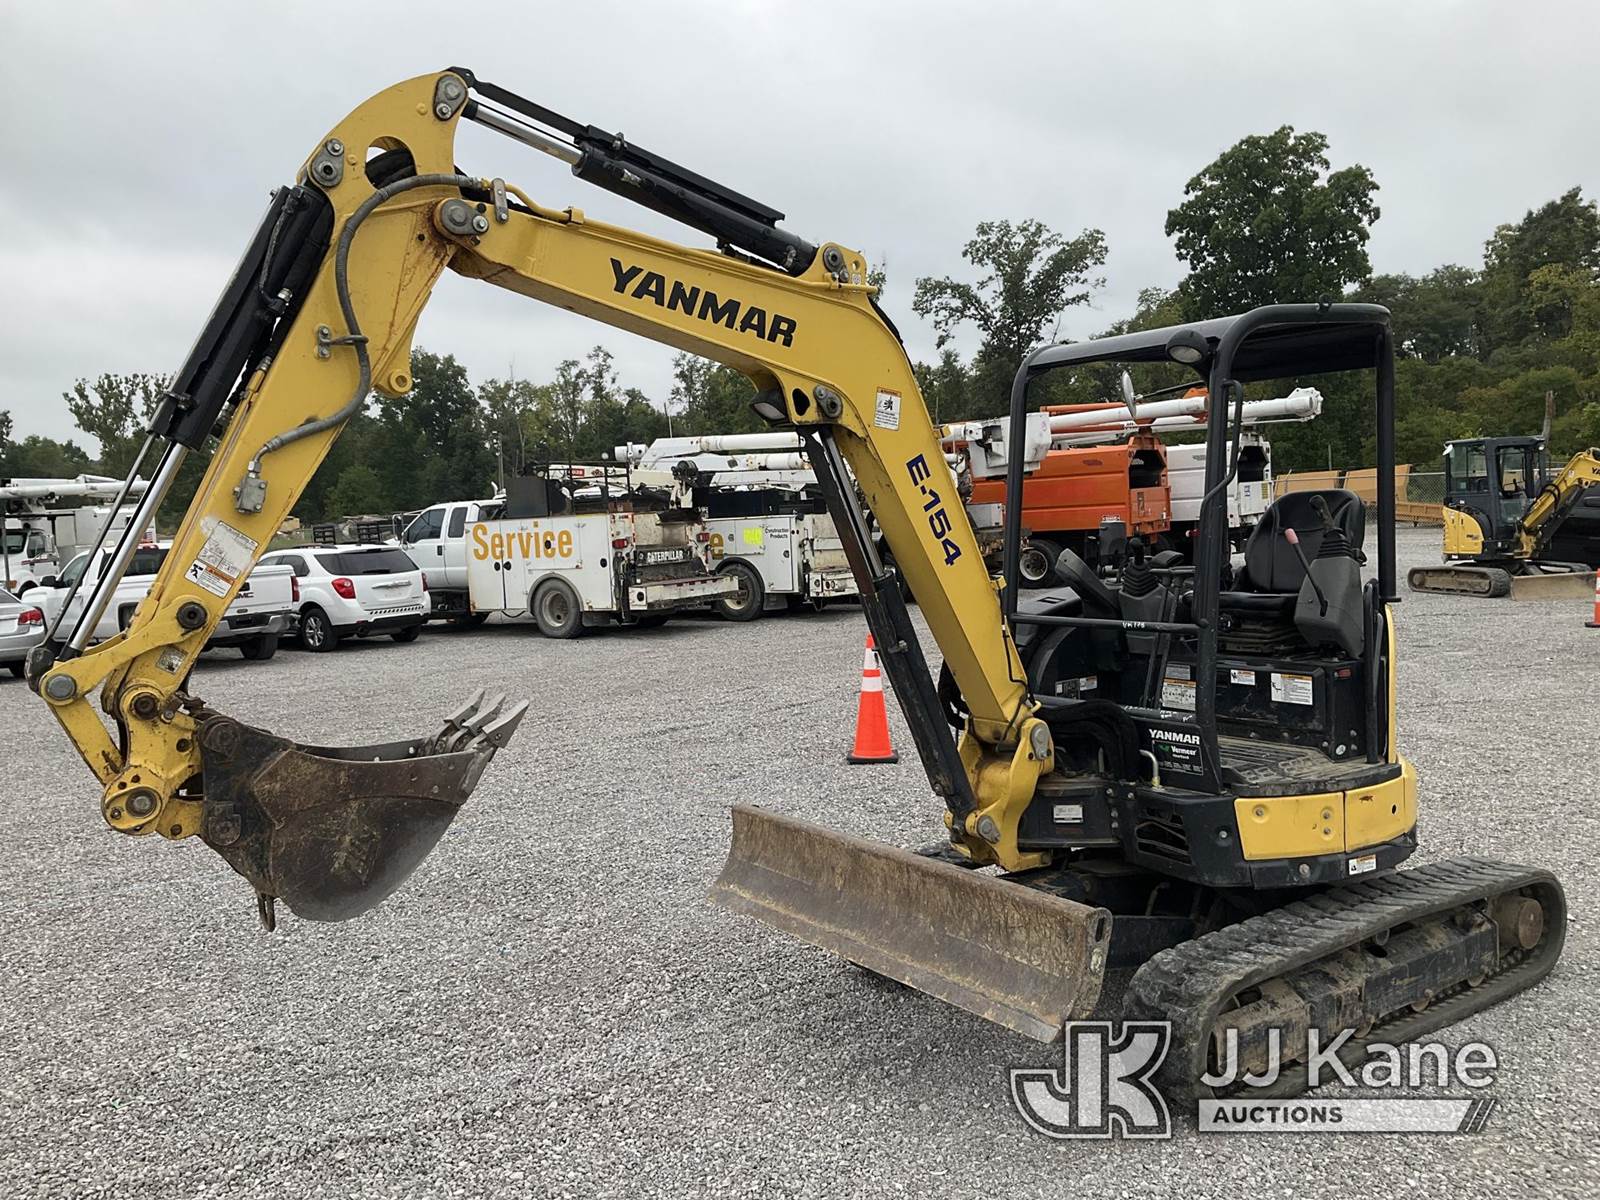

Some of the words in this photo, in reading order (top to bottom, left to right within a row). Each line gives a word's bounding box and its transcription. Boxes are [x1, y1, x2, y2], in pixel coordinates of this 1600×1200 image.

[611, 257, 797, 347] YANMAR
[905, 454, 962, 567] E-154
[472, 521, 573, 561] Service
[647, 550, 684, 561] CATERPILLAR
[237, 591, 254, 599] MC
[1148, 728, 1201, 745] YANMAR
[1170, 745, 1197, 756] Vermeer
